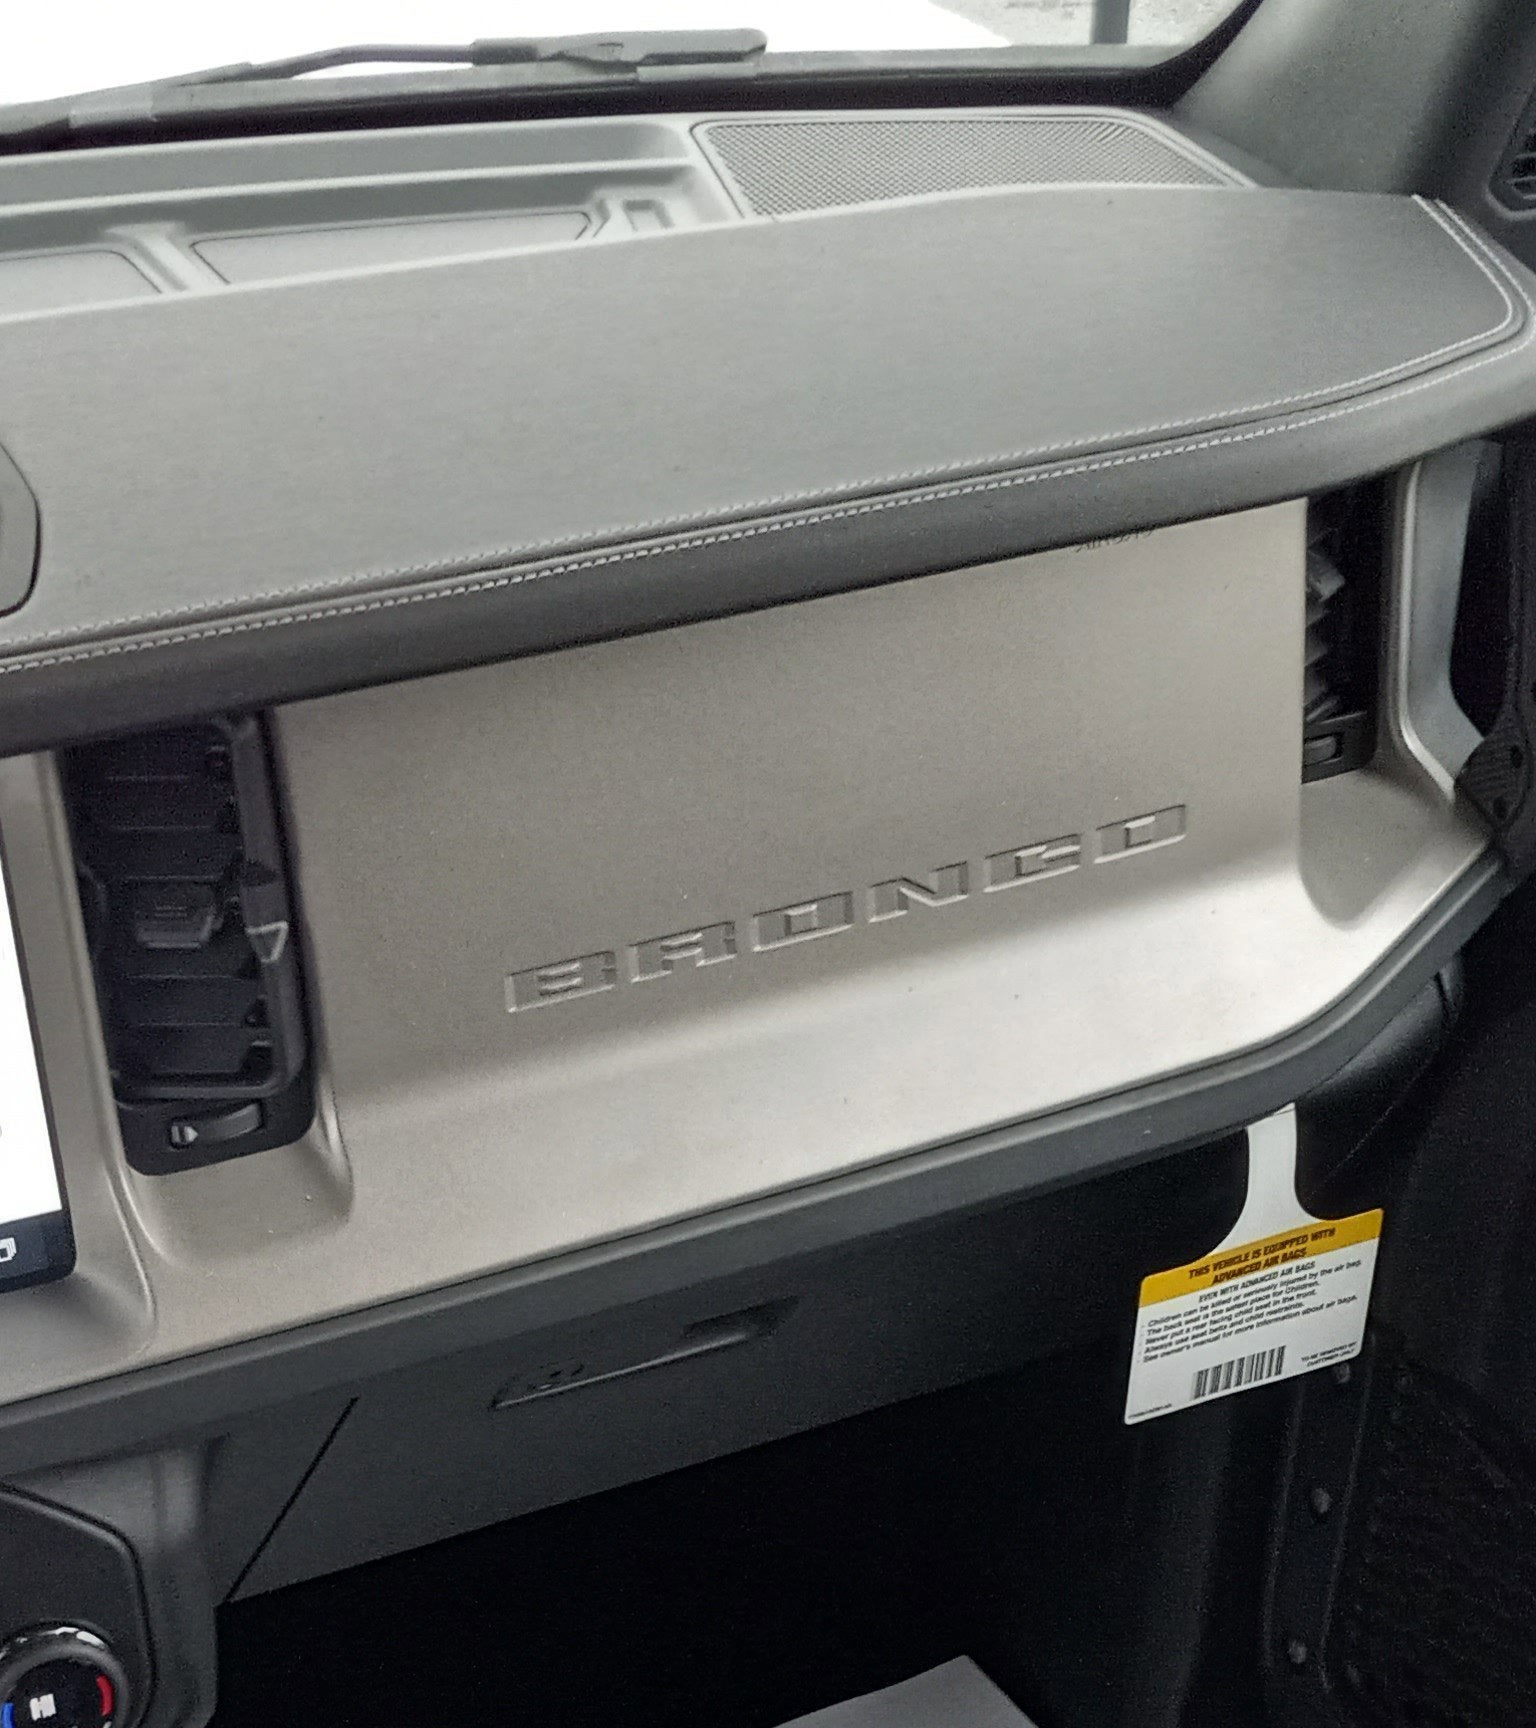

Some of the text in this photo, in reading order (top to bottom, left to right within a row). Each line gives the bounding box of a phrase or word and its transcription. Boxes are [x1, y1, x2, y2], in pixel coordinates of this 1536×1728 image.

[504, 804, 1187, 1013] BRONCO
[1189, 1264, 1211, 1280] THIS
[1212, 1252, 1251, 1272] VEHICLE
[1263, 1234, 1309, 1256] EQUIPPED
[1310, 1227, 1336, 1242] WITH
[1211, 1247, 1307, 1286] ADVANCED AIR BAGS
[1294, 1260, 1316, 1274] BAGS
[29, 1693, 57, 1722] HI
